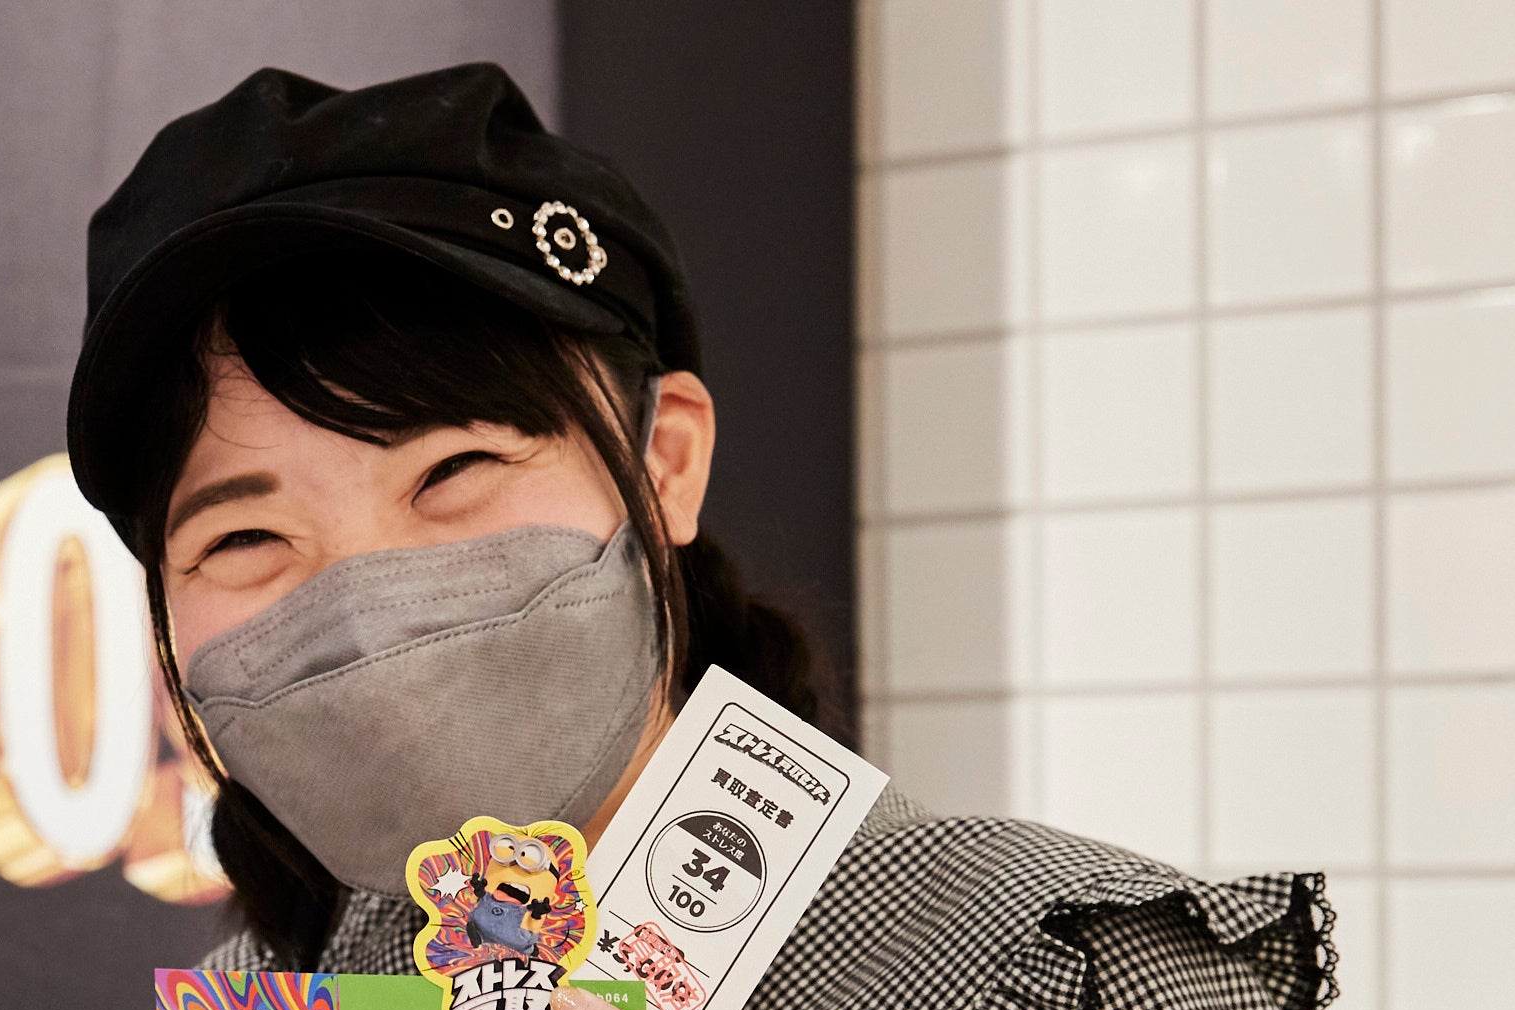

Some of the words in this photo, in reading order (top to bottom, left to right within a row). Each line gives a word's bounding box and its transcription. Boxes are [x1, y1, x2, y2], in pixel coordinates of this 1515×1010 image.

[711, 768, 794, 829] 買取査定書
[703, 829, 745, 860] ストレス度
[712, 822, 747, 847] あなたの
[682, 848, 730, 893] 34
[668, 885, 706, 917] 100
[454, 959, 559, 1002] ストレス
